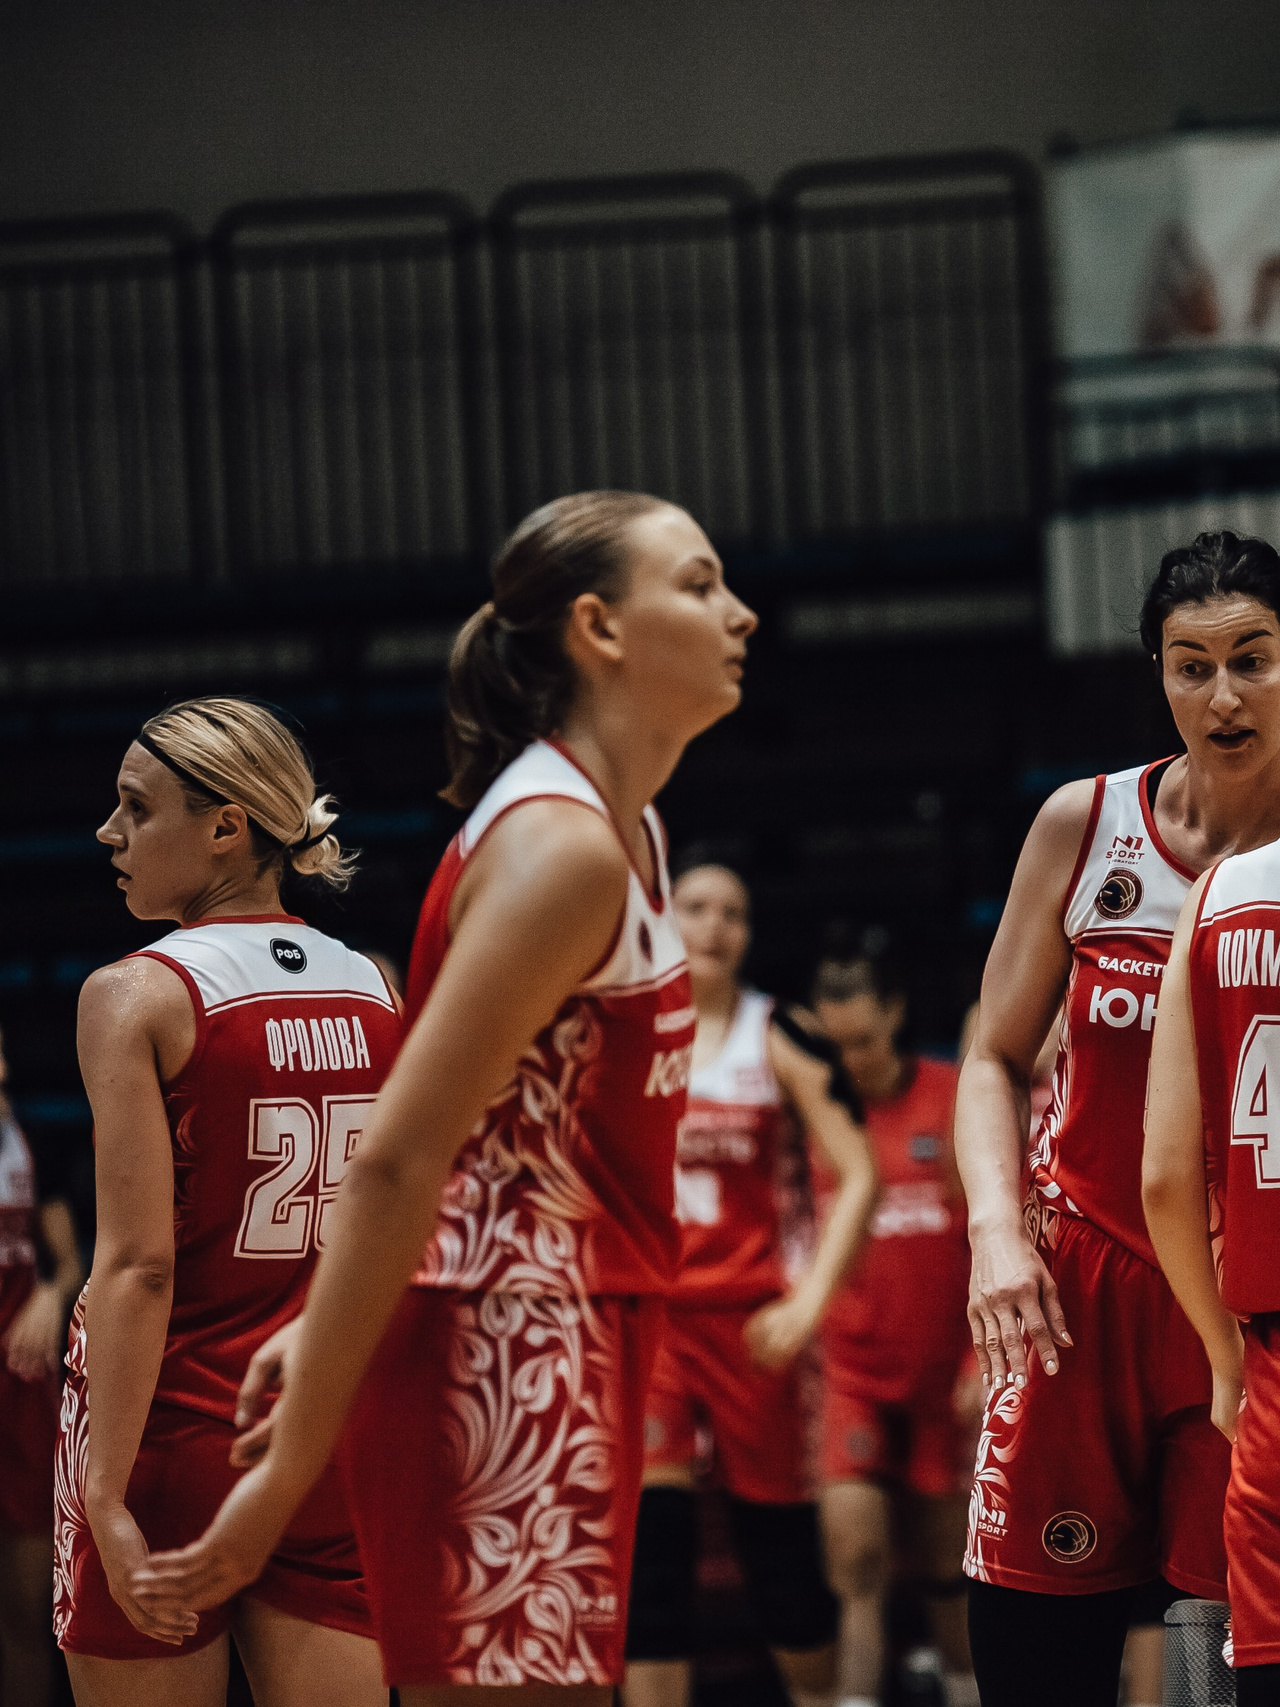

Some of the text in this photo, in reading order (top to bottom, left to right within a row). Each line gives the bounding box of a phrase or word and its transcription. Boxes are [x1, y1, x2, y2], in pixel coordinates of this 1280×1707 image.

[276, 948, 302, 961] РФБ
[1098, 955, 1167, 979] БАСКЕТ
[265, 1016, 371, 1071] ФРОЛОВА
[977, 1521, 1009, 1537] SPORT
